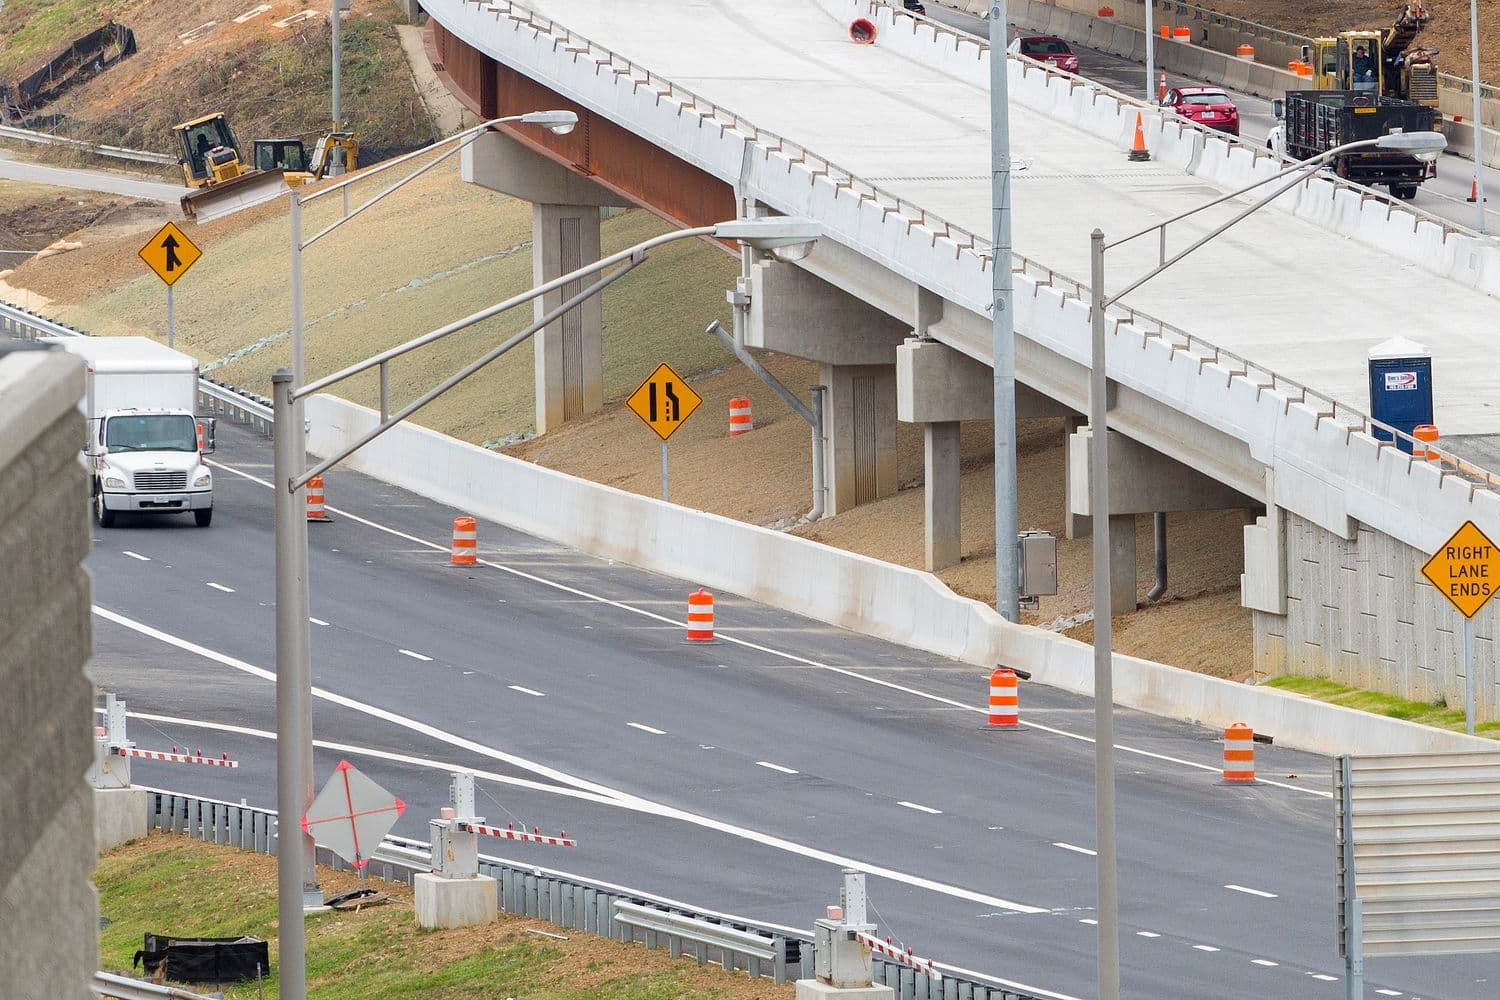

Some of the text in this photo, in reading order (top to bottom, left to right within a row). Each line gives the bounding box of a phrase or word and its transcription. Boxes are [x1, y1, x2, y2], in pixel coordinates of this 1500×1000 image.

[1446, 546, 1492, 560] RIGHT
[1449, 564, 1489, 578] LANE
[1450, 582, 1491, 597] ENDS
